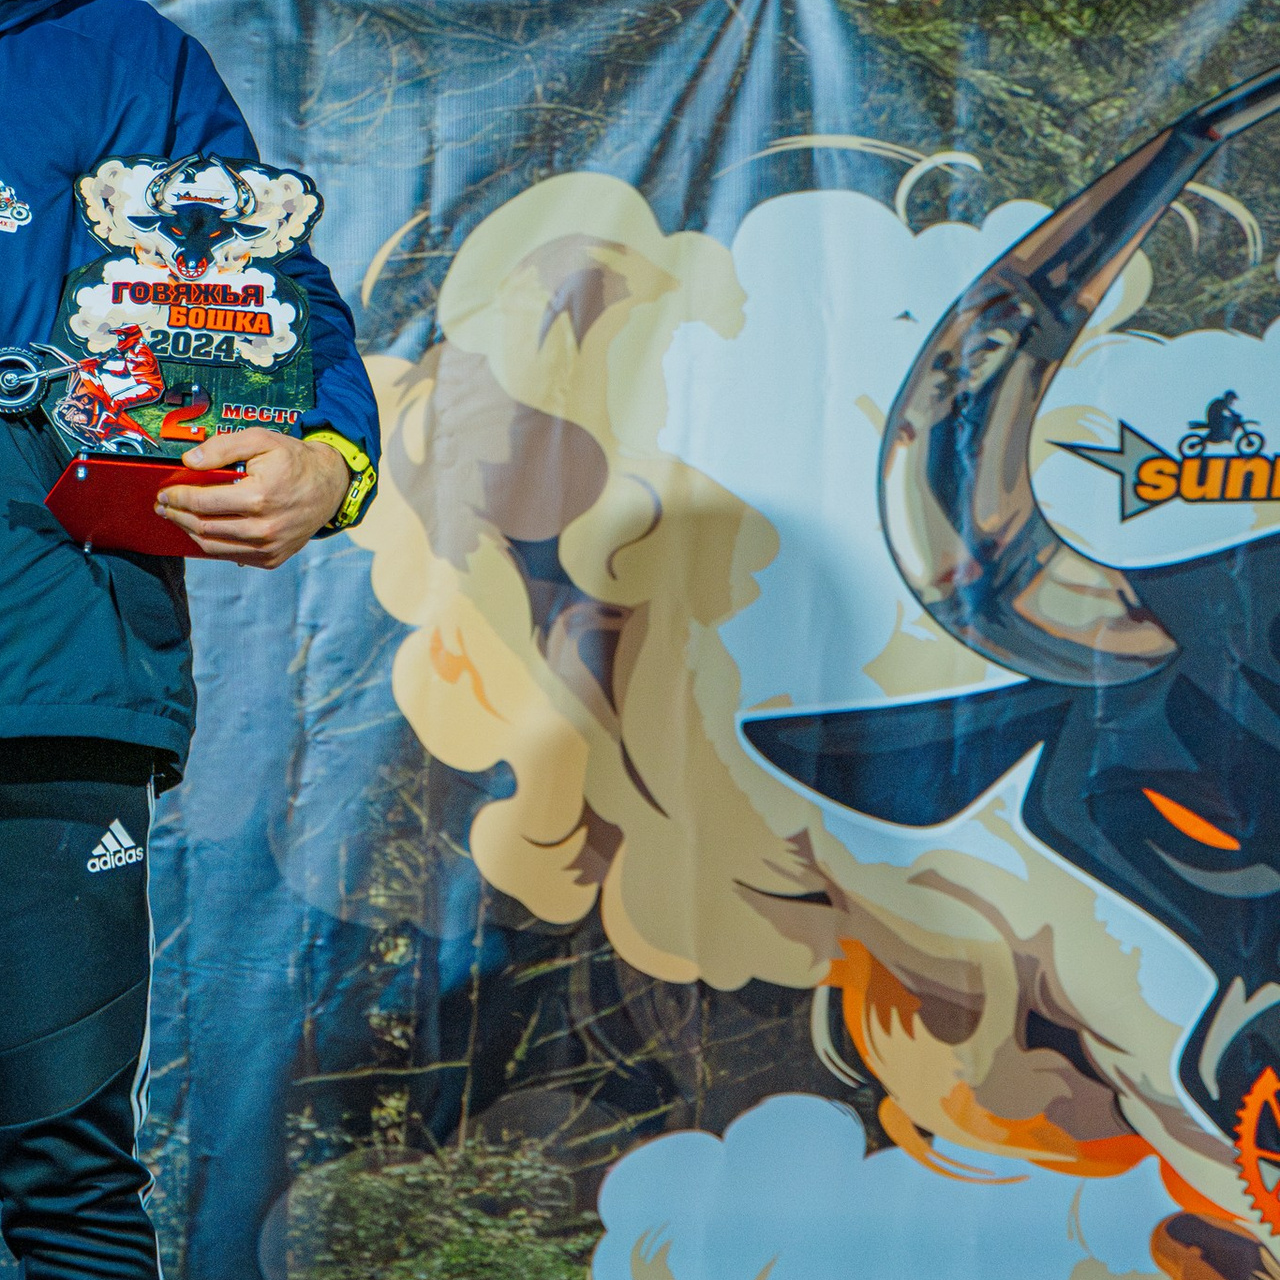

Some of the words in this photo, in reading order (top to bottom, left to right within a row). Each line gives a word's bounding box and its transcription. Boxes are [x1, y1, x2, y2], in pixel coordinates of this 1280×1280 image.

[111, 281, 265, 307] ГОВЯЖЬЯ
[168, 306, 274, 337] БОШКА
[149, 329, 237, 361] 2024
[159, 382, 210, 442] 2
[1134, 454, 1280, 502] sun
[86, 846, 144, 873] adidas
